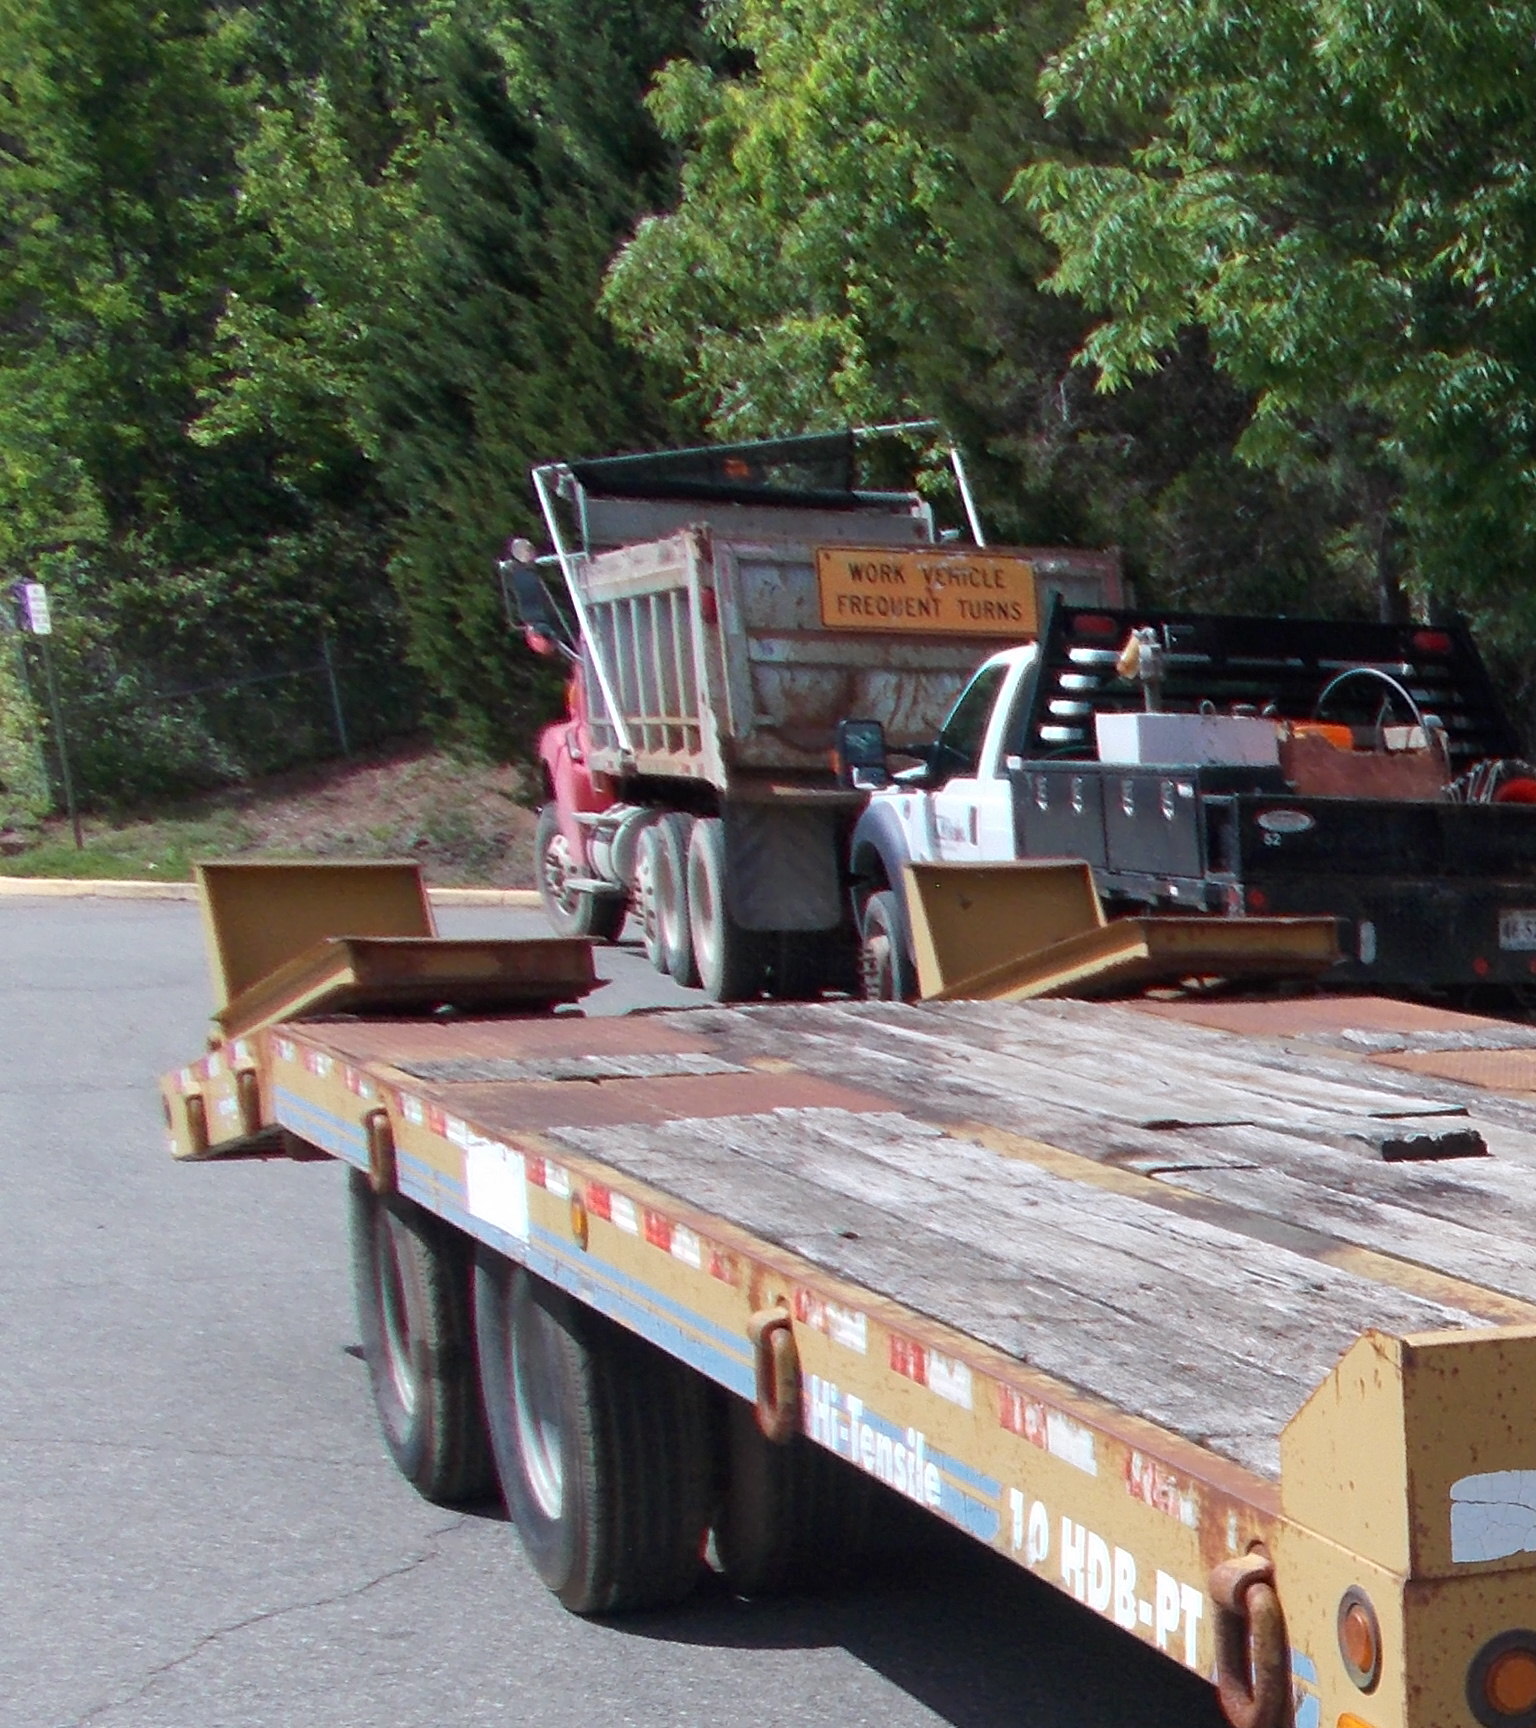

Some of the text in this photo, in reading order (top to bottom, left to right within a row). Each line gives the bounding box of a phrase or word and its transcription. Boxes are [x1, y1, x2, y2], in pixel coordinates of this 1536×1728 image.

[836, 594, 1022, 621] FREQUENT TURNS
[848, 563, 1005, 589] WORK VEHICLE
[811, 1374, 942, 1506] Hi-Tensile
[1010, 1487, 1204, 1669] 10 HDB-PT
